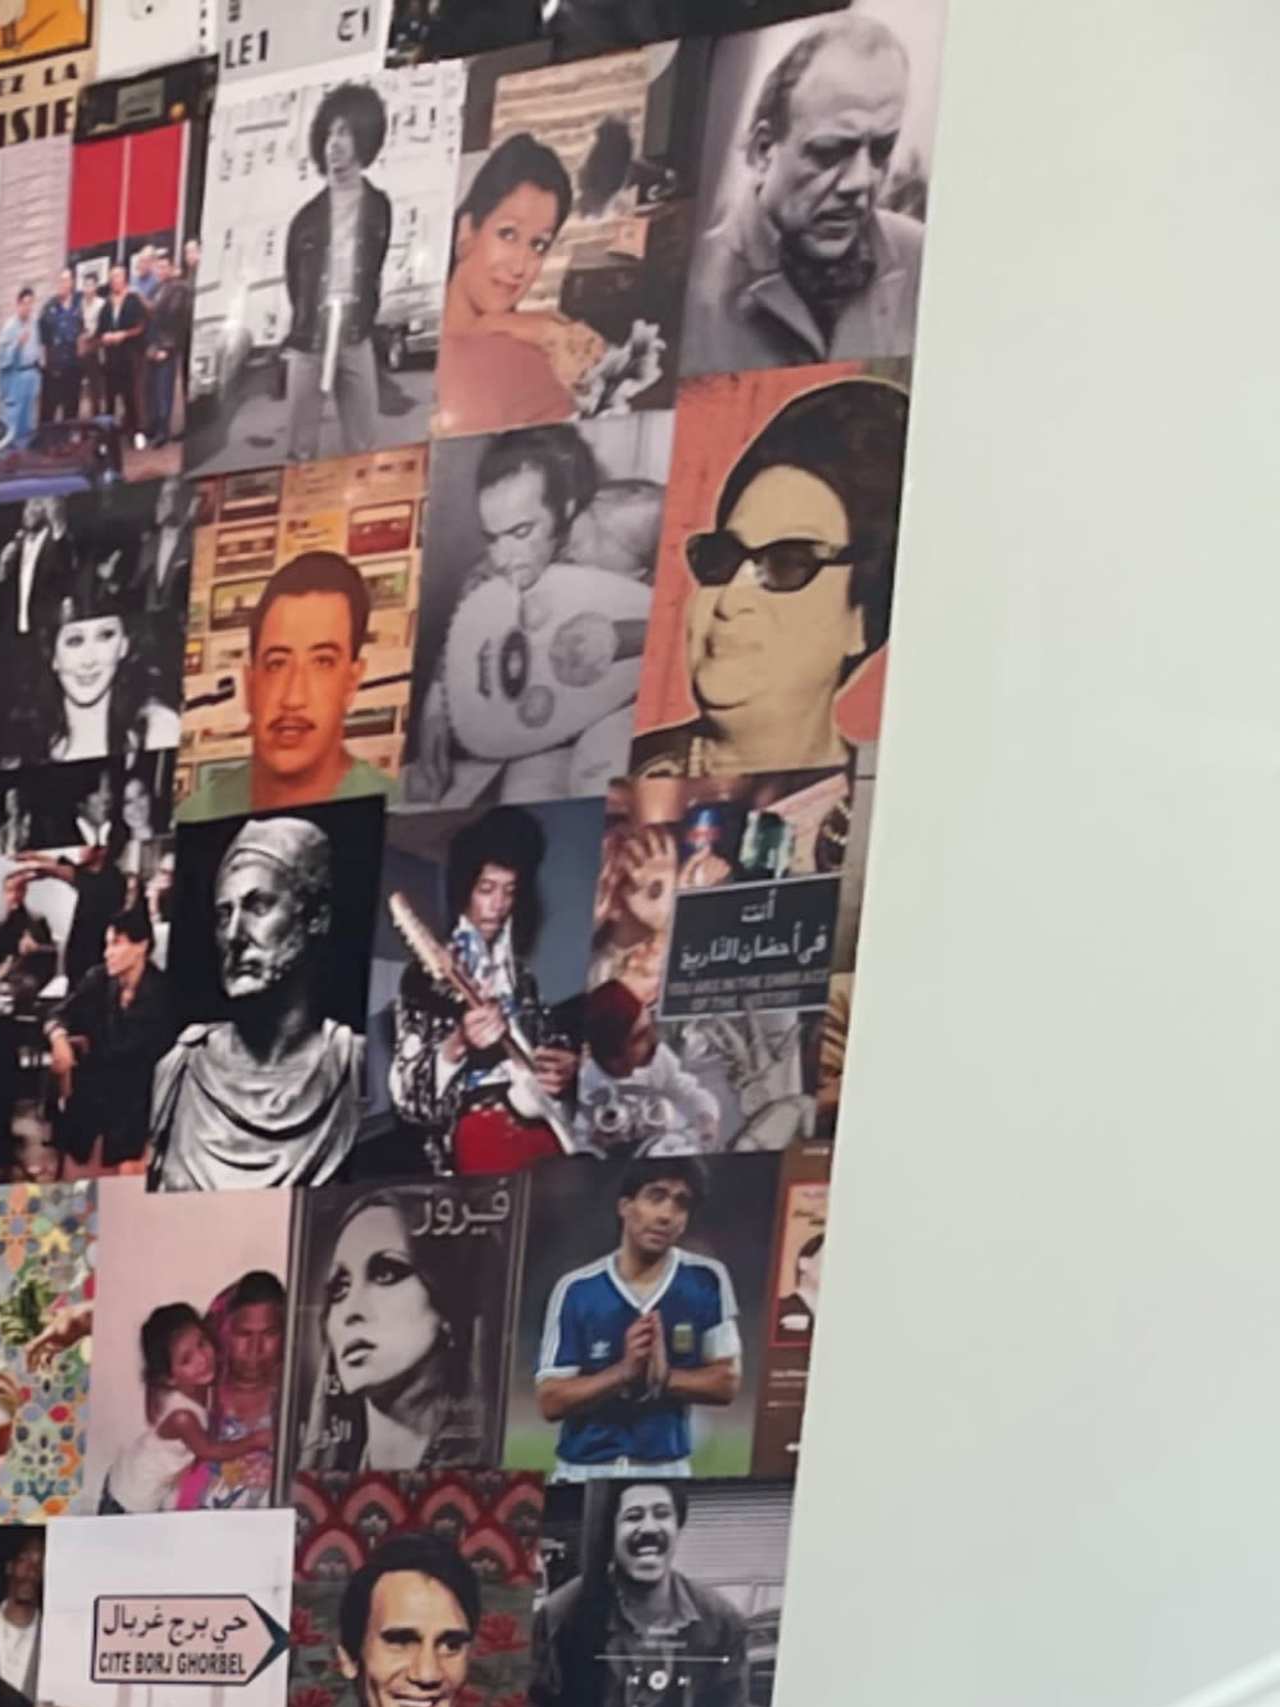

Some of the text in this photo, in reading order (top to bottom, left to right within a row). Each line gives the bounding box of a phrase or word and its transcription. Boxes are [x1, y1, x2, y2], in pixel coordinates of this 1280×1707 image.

[43, 62, 79, 86] LA
[411, 1177, 510, 1236] فيروز
[103, 1604, 248, 1650] حي برج غربال
[99, 1651, 246, 1675] CITE BORJ GHORBEL
